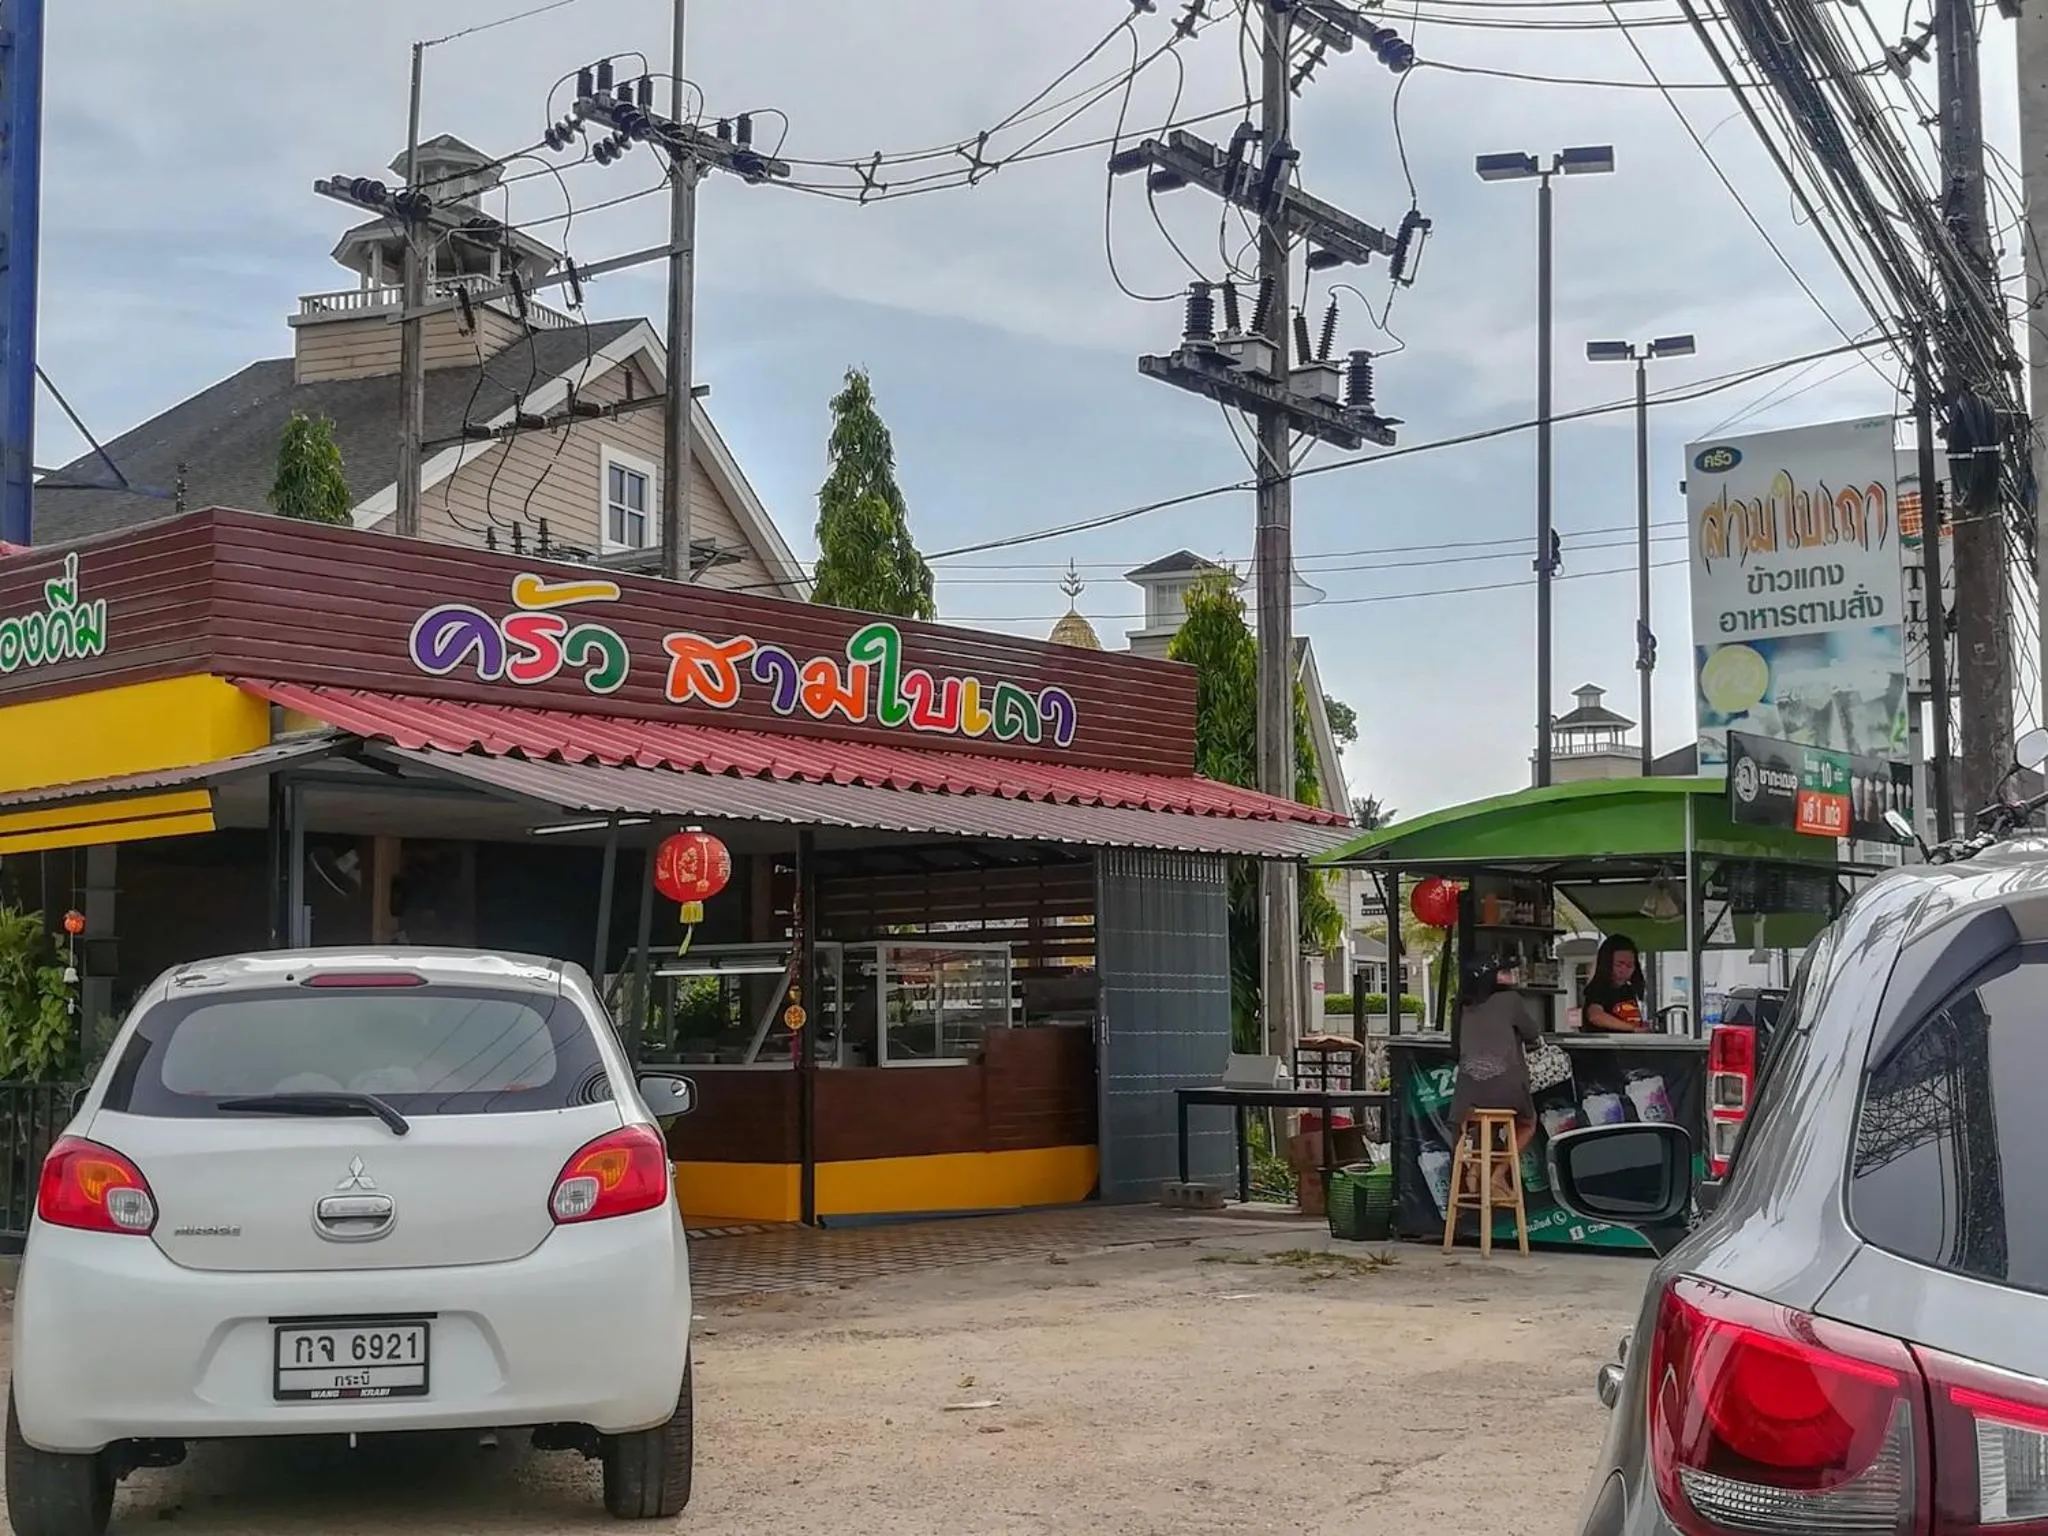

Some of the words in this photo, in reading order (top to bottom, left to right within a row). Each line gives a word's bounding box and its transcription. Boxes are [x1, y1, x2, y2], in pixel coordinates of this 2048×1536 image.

[1703, 450, 1732, 468] ครัว
[1747, 563, 1844, 595] ข้าวแกง
[1719, 583, 1884, 634] อาหารตามสั่ง
[409, 572, 630, 695] ครัว
[295, 1335, 335, 1363] กจ
[351, 1332, 416, 1361] 6921
